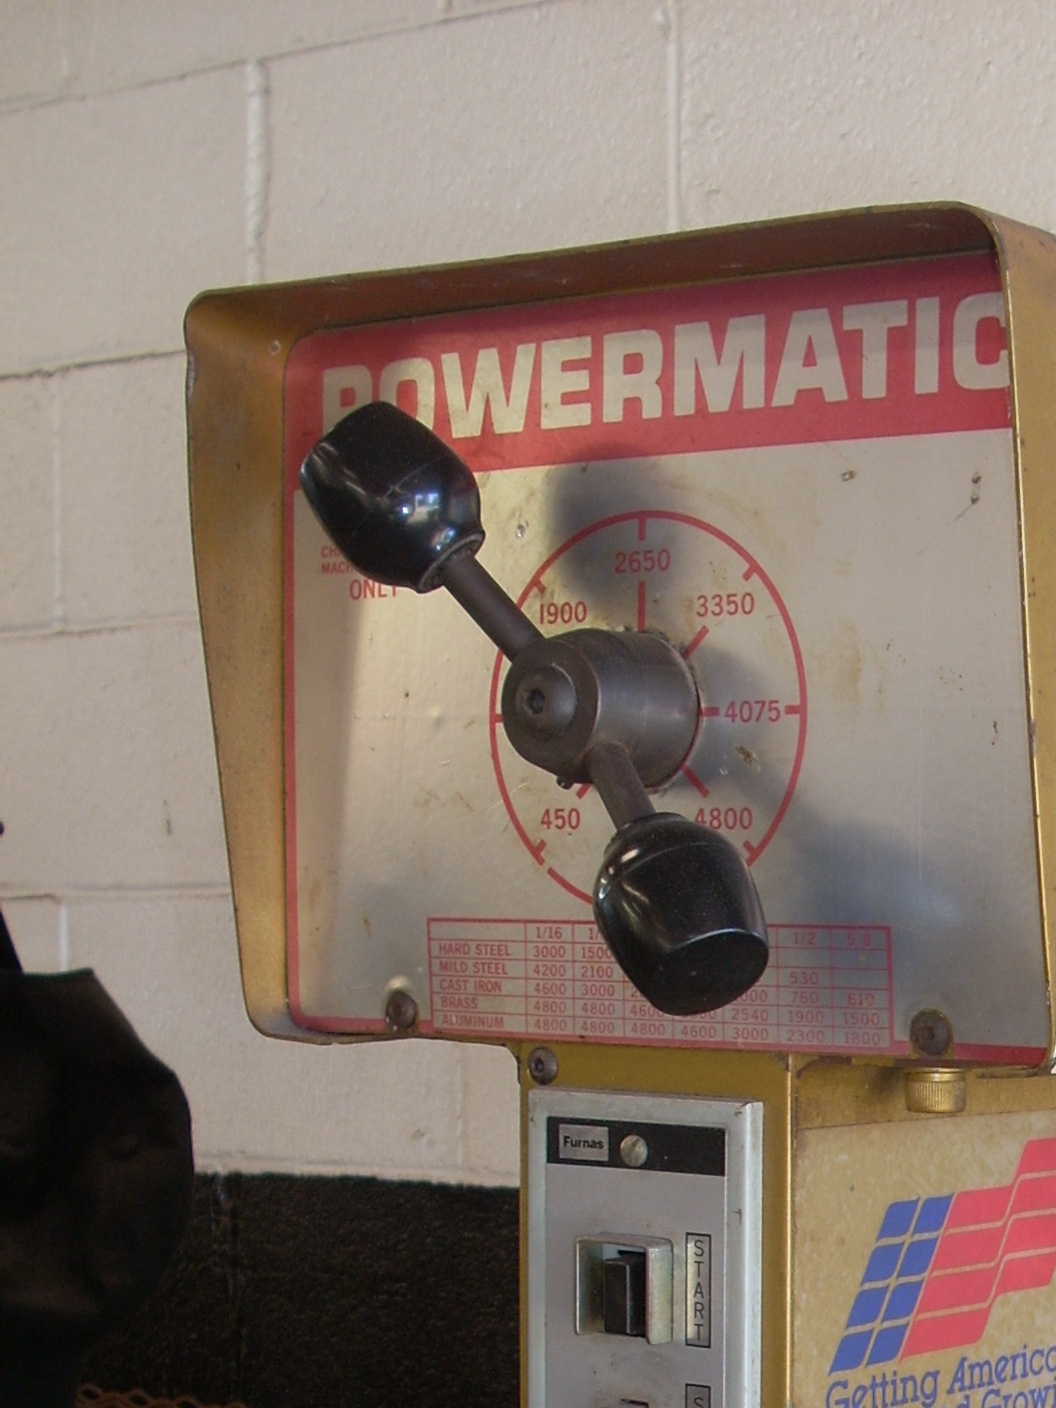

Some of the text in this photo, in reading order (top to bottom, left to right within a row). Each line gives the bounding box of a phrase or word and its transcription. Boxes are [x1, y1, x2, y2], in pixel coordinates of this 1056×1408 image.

[322, 292, 1009, 439] POWERMATIC
[614, 549, 671, 574] 2650
[539, 601, 587, 625] 1900
[696, 592, 755, 618] 3350
[725, 700, 781, 723] 4075
[540, 808, 581, 830] 450
[695, 806, 753, 830] 4800
[536, 927, 562, 940] 1/16
[438, 943, 613, 959] HARD STEEL 3000 1500
[439, 961, 819, 986] MILD STEEL 4200 2100 530
[440, 979, 468, 991] CAST
[474, 980, 502, 992] IRON
[534, 982, 567, 996] 4600
[582, 983, 615, 997] 3000
[441, 997, 478, 1010] BRASS
[534, 1001, 567, 1014] 4800
[582, 1002, 615, 1015] 4800
[731, 1008, 768, 1022] 2540
[788, 1011, 824, 1025] 1900
[442, 1015, 504, 1029] ALUMINUM
[534, 1018, 568, 1032] 4800
[581, 1020, 615, 1034] 4800
[631, 1022, 666, 1036] 4800
[733, 1027, 769, 1041] 3000
[563, 1136, 604, 1150] Furnas
[693, 1239, 705, 1341] START
